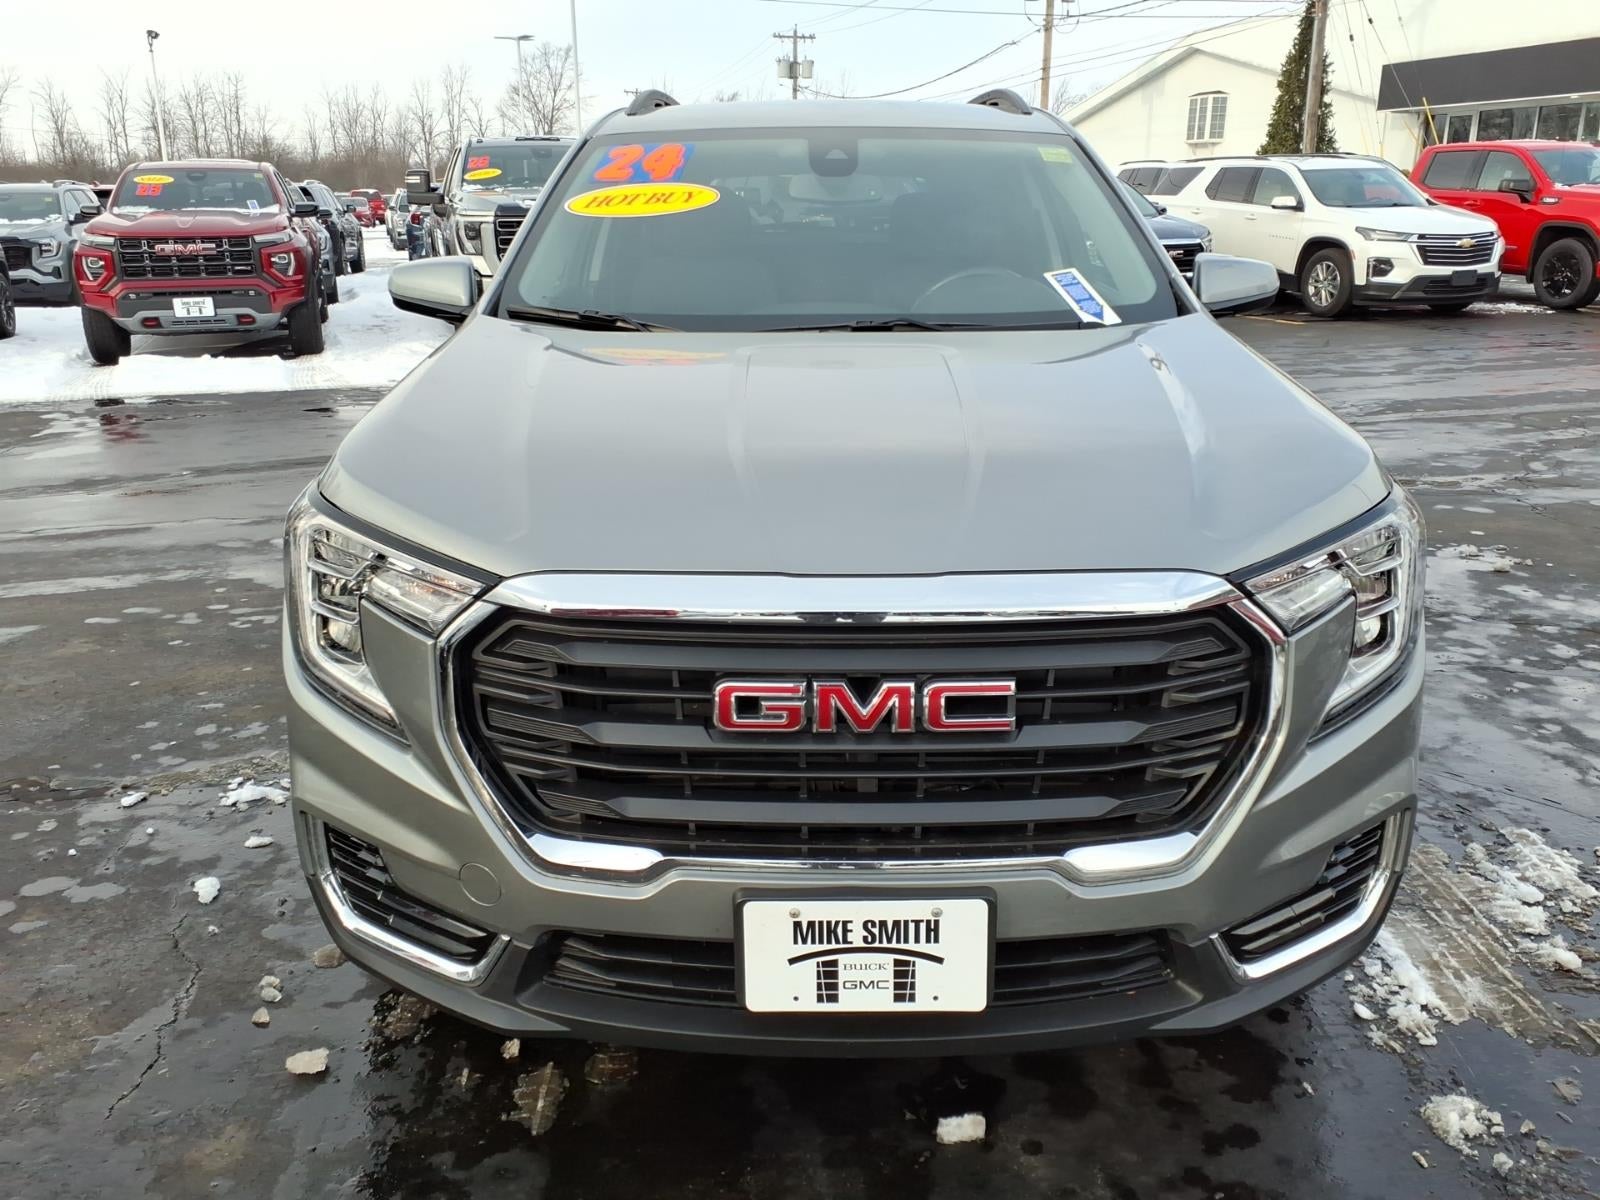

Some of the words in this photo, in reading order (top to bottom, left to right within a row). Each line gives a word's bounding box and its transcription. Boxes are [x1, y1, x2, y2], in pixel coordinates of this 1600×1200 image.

[594, 143, 686, 181] 24
[585, 194, 645, 208] HOT
[645, 191, 702, 205] BUY
[155, 244, 216, 255] GMC
[714, 679, 1016, 732] GMC
[793, 920, 854, 945] MIKE
[862, 919, 940, 945] SMITH
[843, 962, 888, 971] BUICK
[842, 980, 890, 990] GMC
